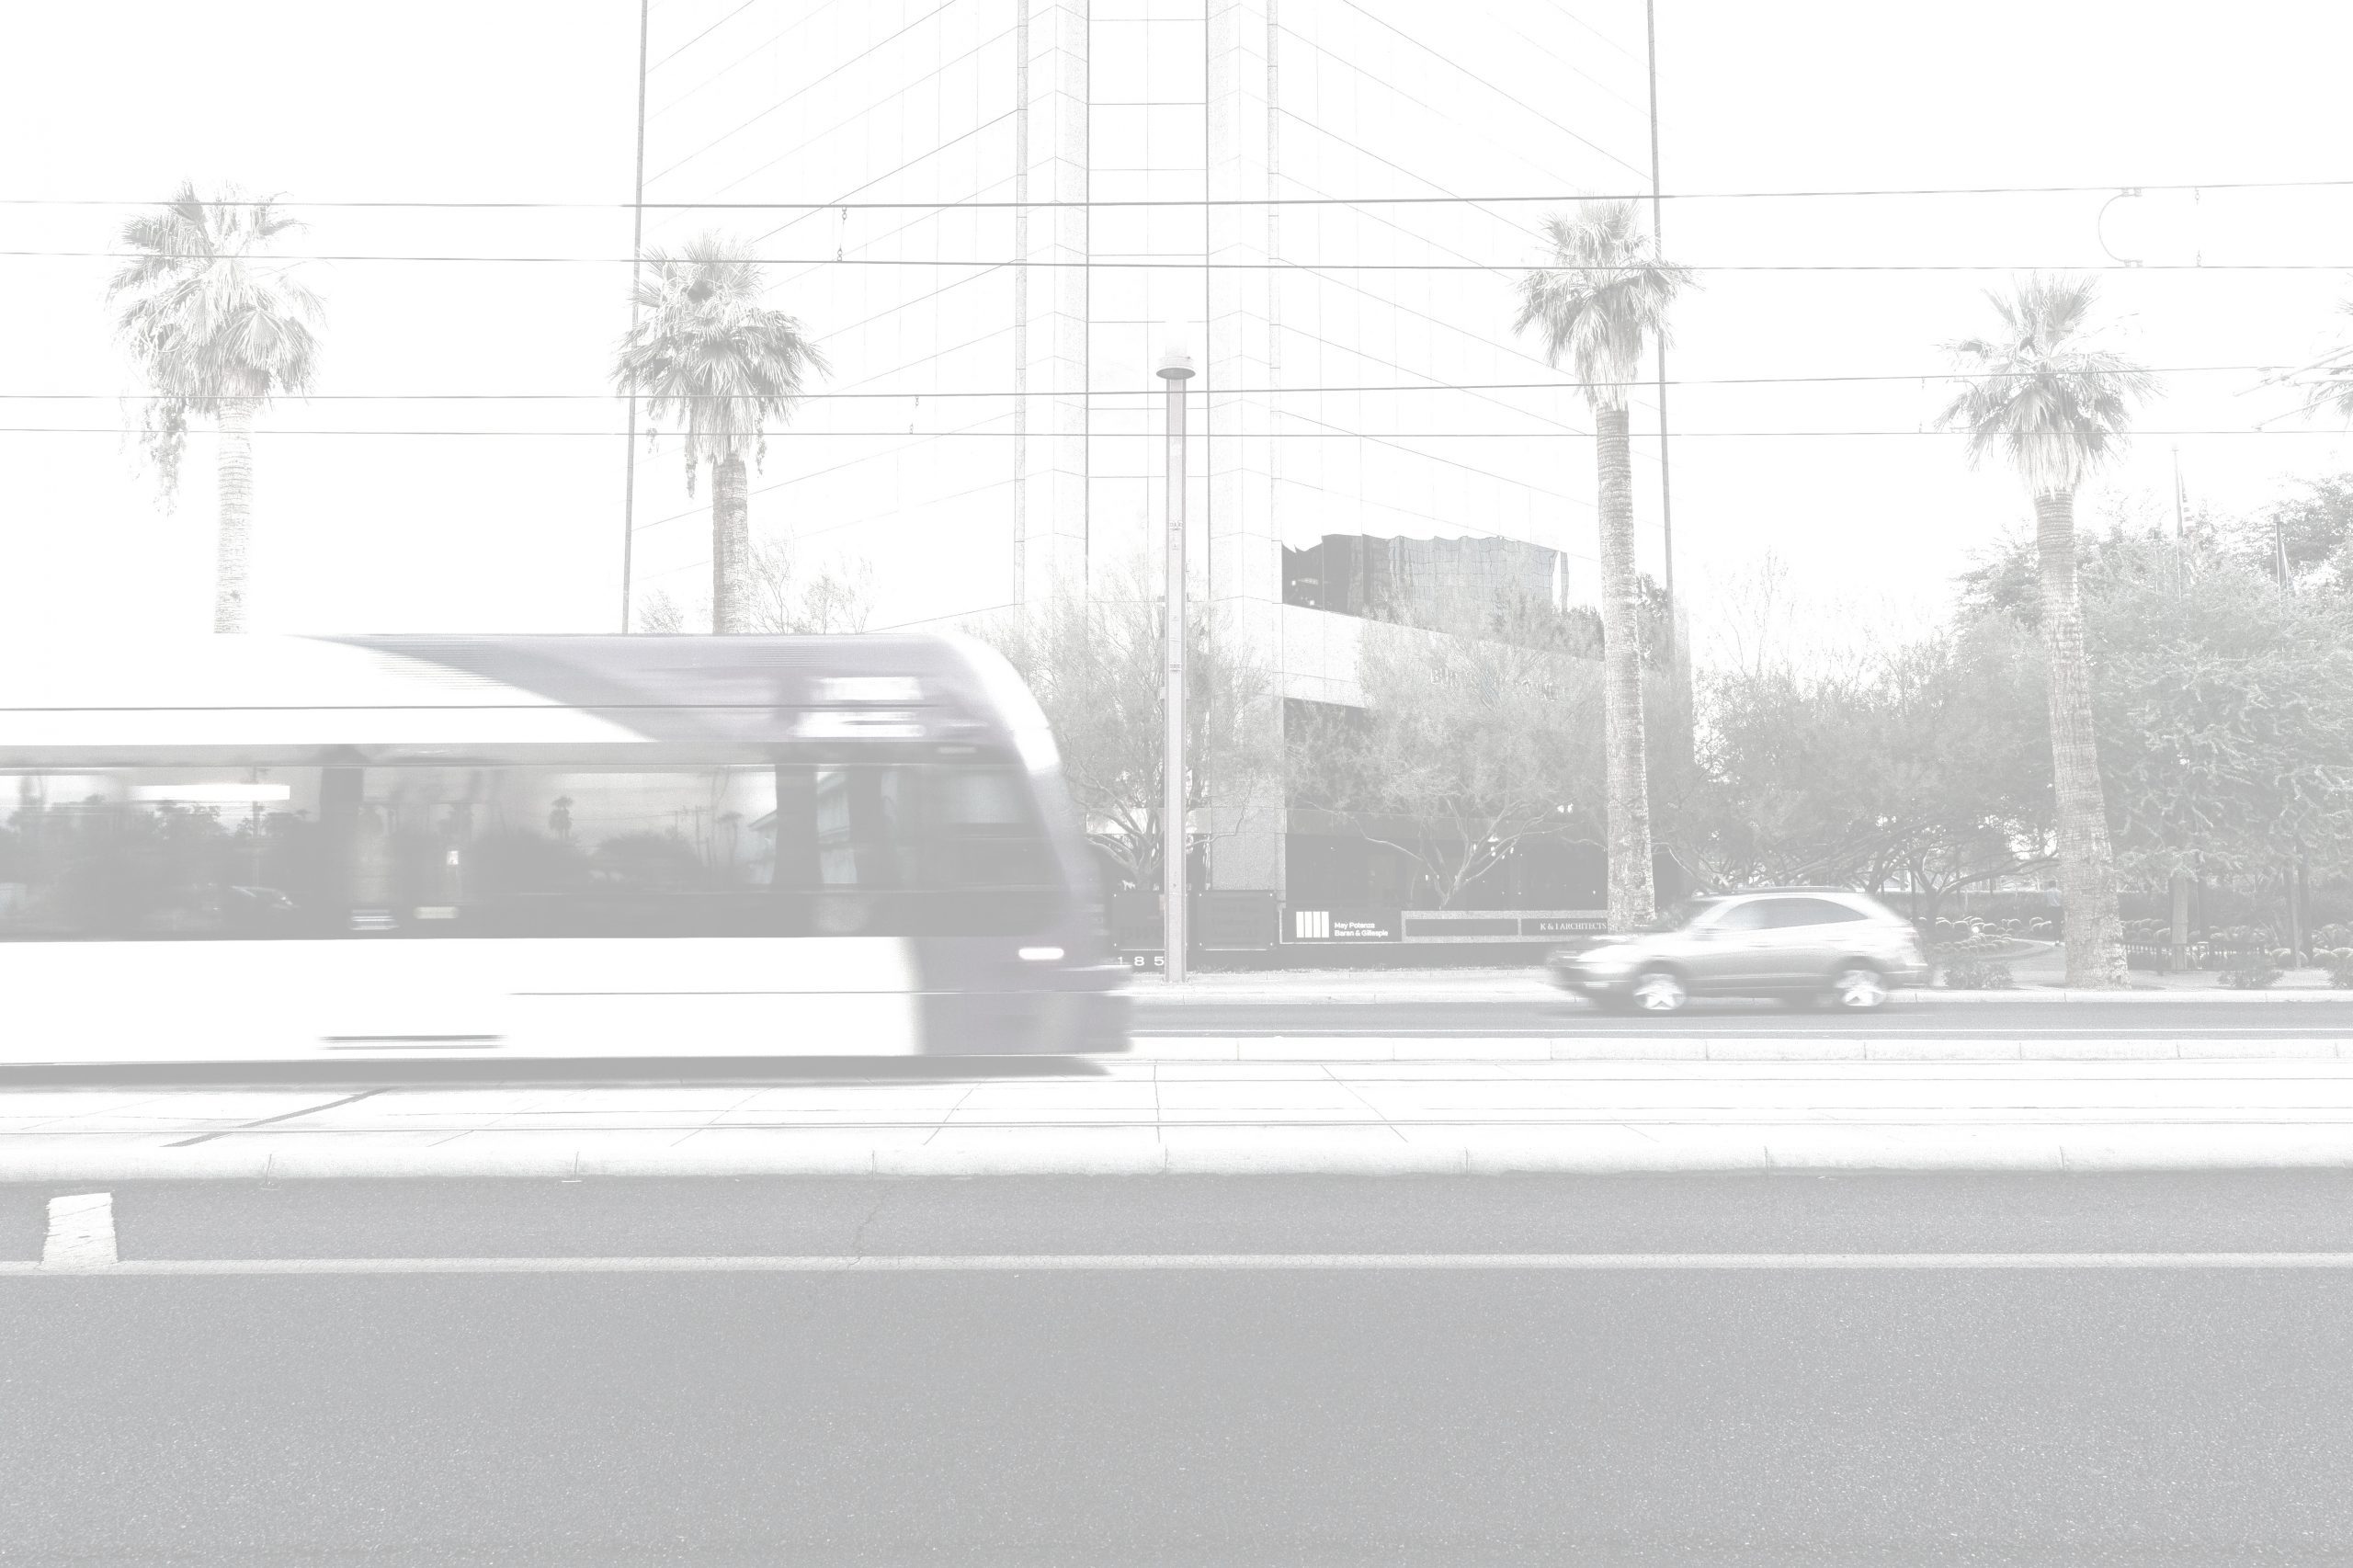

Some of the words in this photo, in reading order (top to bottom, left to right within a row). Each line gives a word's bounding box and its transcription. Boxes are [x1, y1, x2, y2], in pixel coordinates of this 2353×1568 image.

[1334, 922, 1347, 930] May
[1540, 923, 1546, 931] K
[1560, 922, 1607, 930] ARCHITECTS
[1361, 929, 1389, 937] Gillespie
